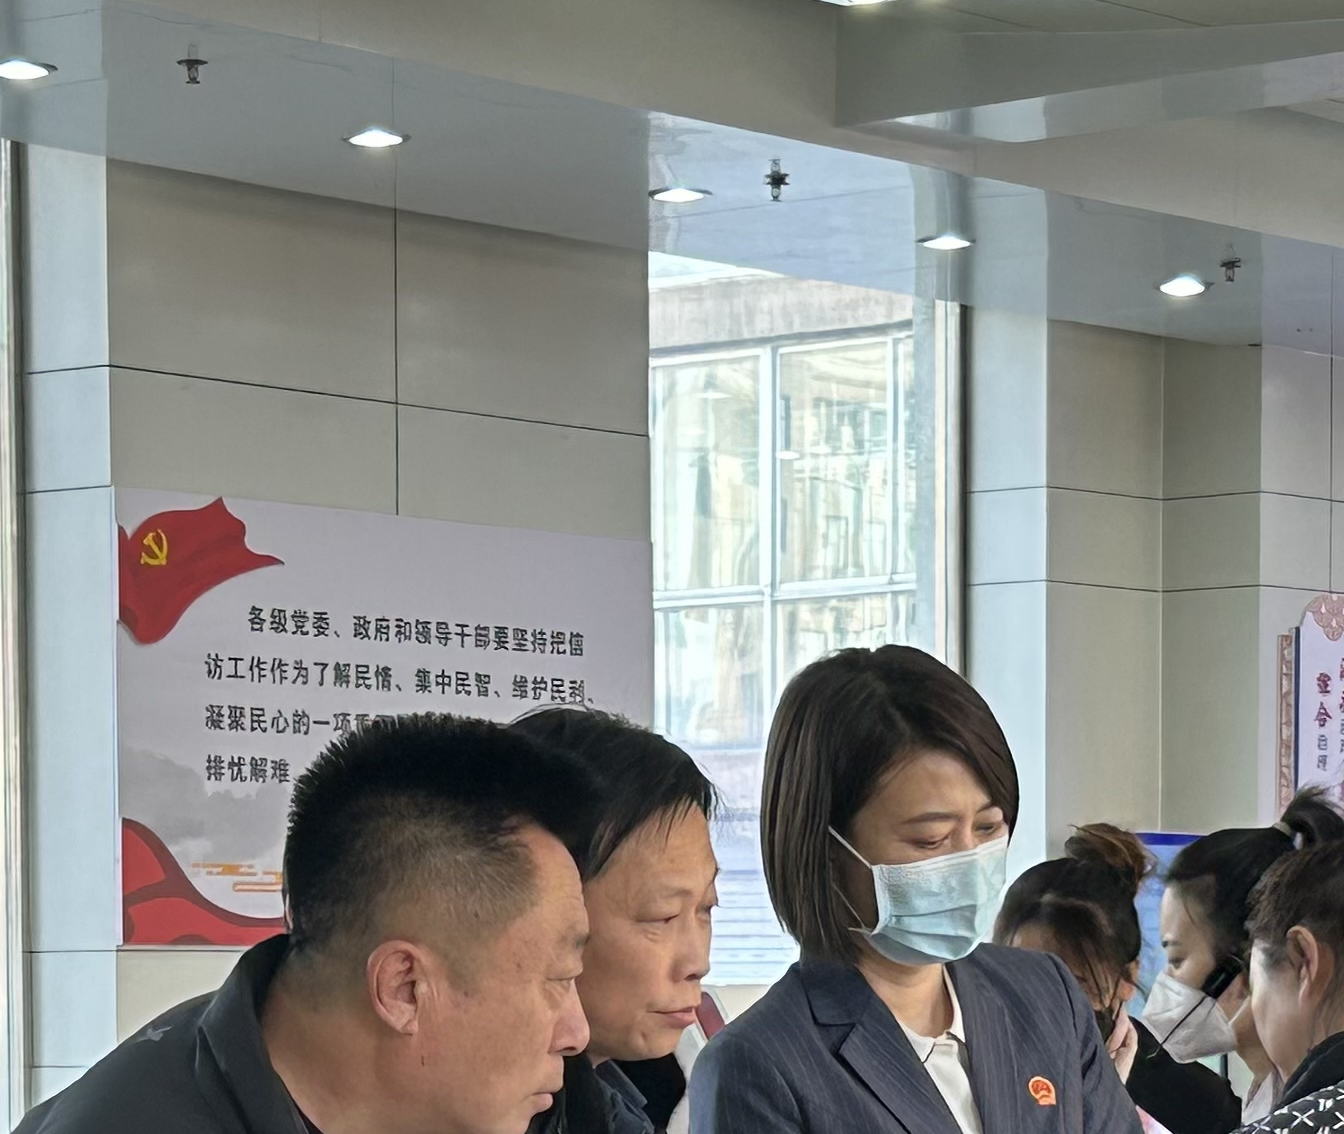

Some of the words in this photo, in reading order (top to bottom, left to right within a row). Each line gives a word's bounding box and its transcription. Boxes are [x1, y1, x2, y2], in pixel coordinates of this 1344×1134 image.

[205, 704, 401, 742] 凝聚民心的一项
